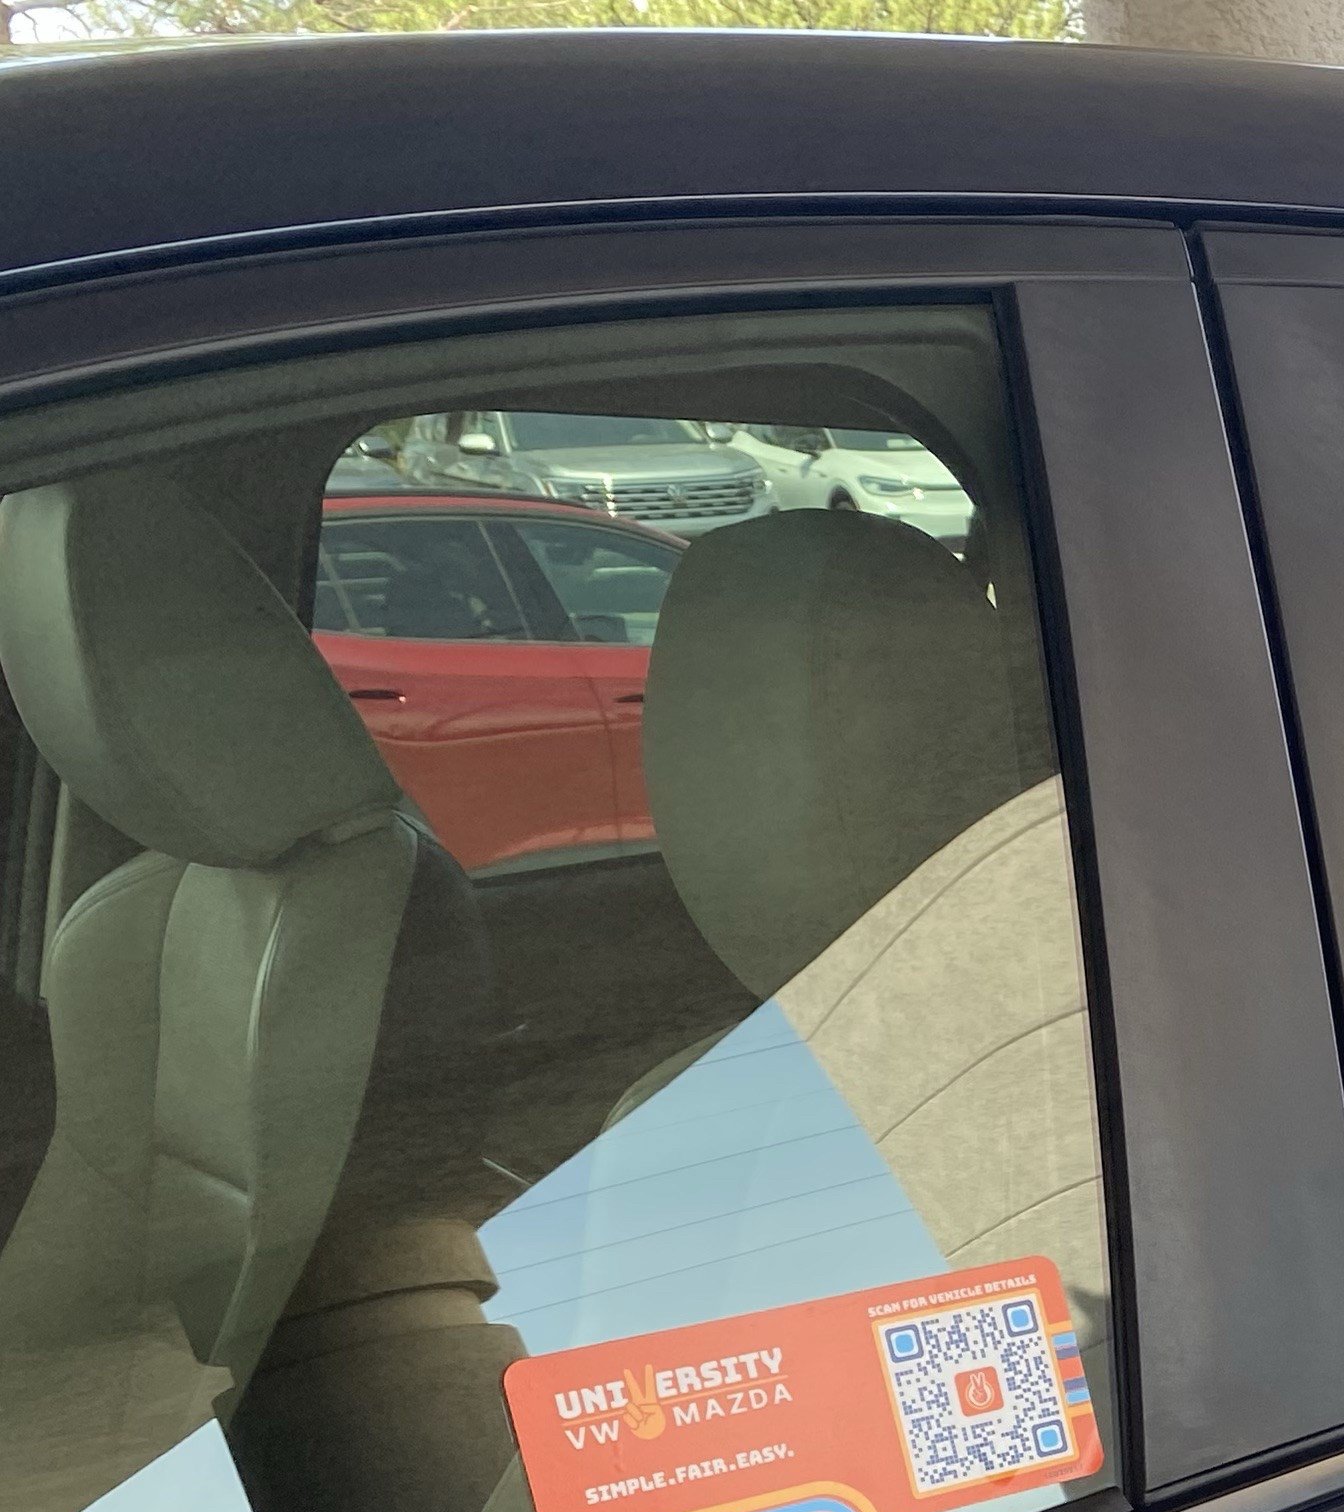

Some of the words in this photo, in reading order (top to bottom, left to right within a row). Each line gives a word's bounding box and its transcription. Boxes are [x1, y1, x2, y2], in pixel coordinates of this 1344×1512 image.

[867, 1302, 901, 1318] SCAN
[902, 1296, 929, 1312] FOR
[928, 1284, 984, 1306] VEHICLE
[984, 1273, 1038, 1295] DETAILS
[554, 1347, 783, 1420] UNIVERSITY
[564, 1419, 620, 1450] VW
[672, 1383, 794, 1427] MAZDA
[584, 1443, 795, 1506] SIMPLE.FAIR.EASY.
